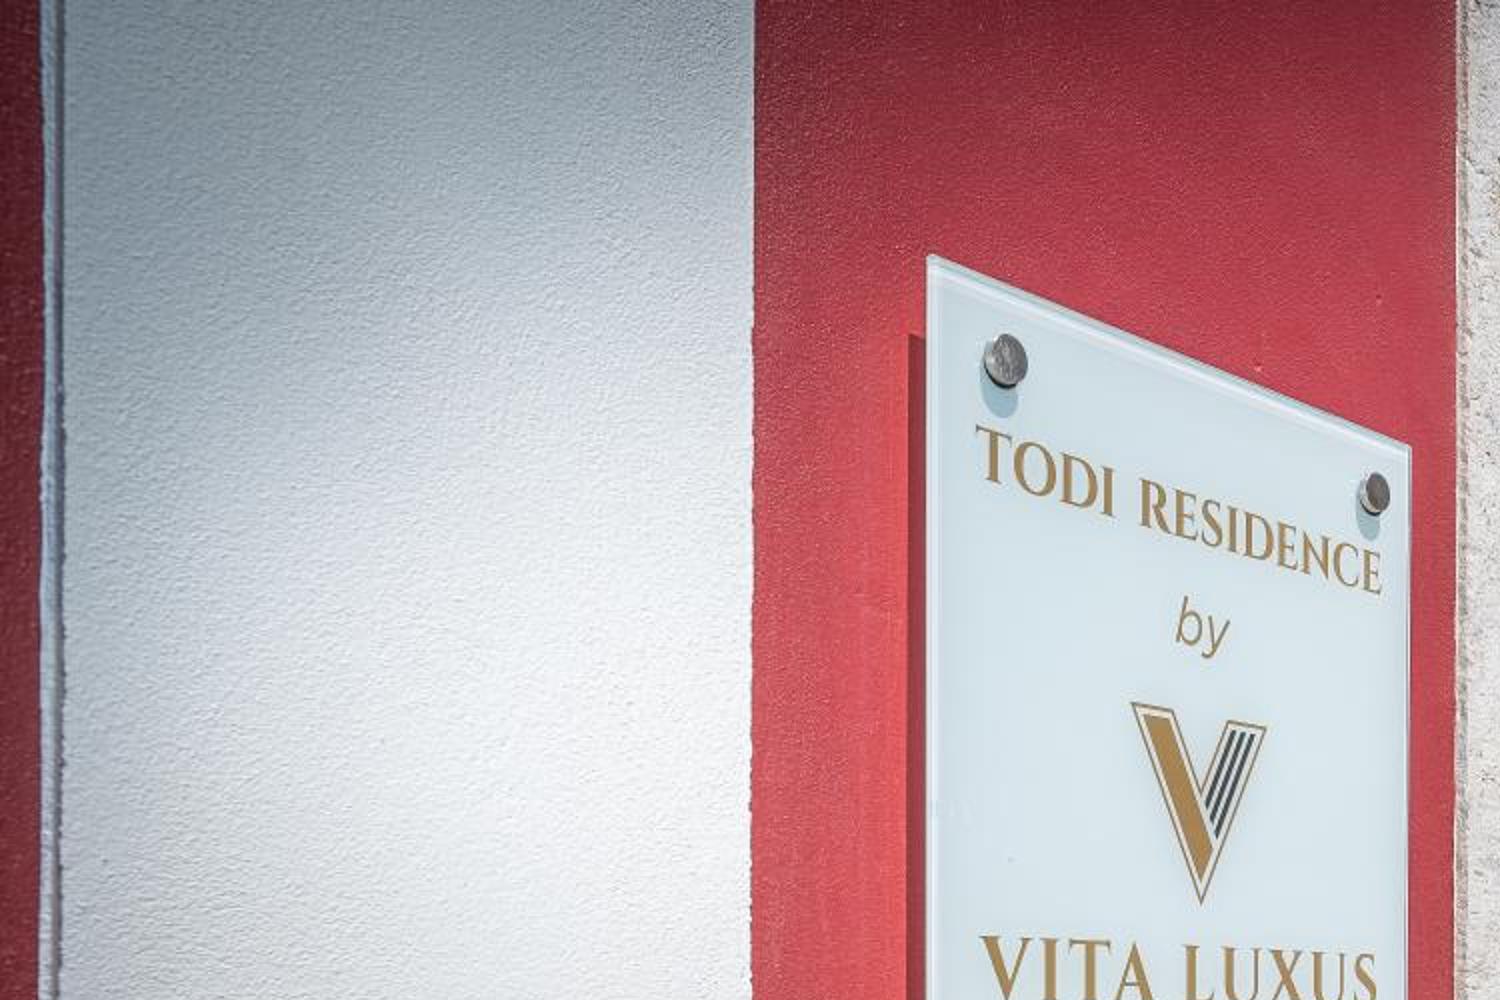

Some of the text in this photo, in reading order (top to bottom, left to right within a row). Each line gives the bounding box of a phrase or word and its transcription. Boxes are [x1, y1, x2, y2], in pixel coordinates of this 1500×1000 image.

[975, 424, 1383, 596] TODI RESIDENCE
[1175, 595, 1231, 659] by
[1131, 701, 1267, 905] V
